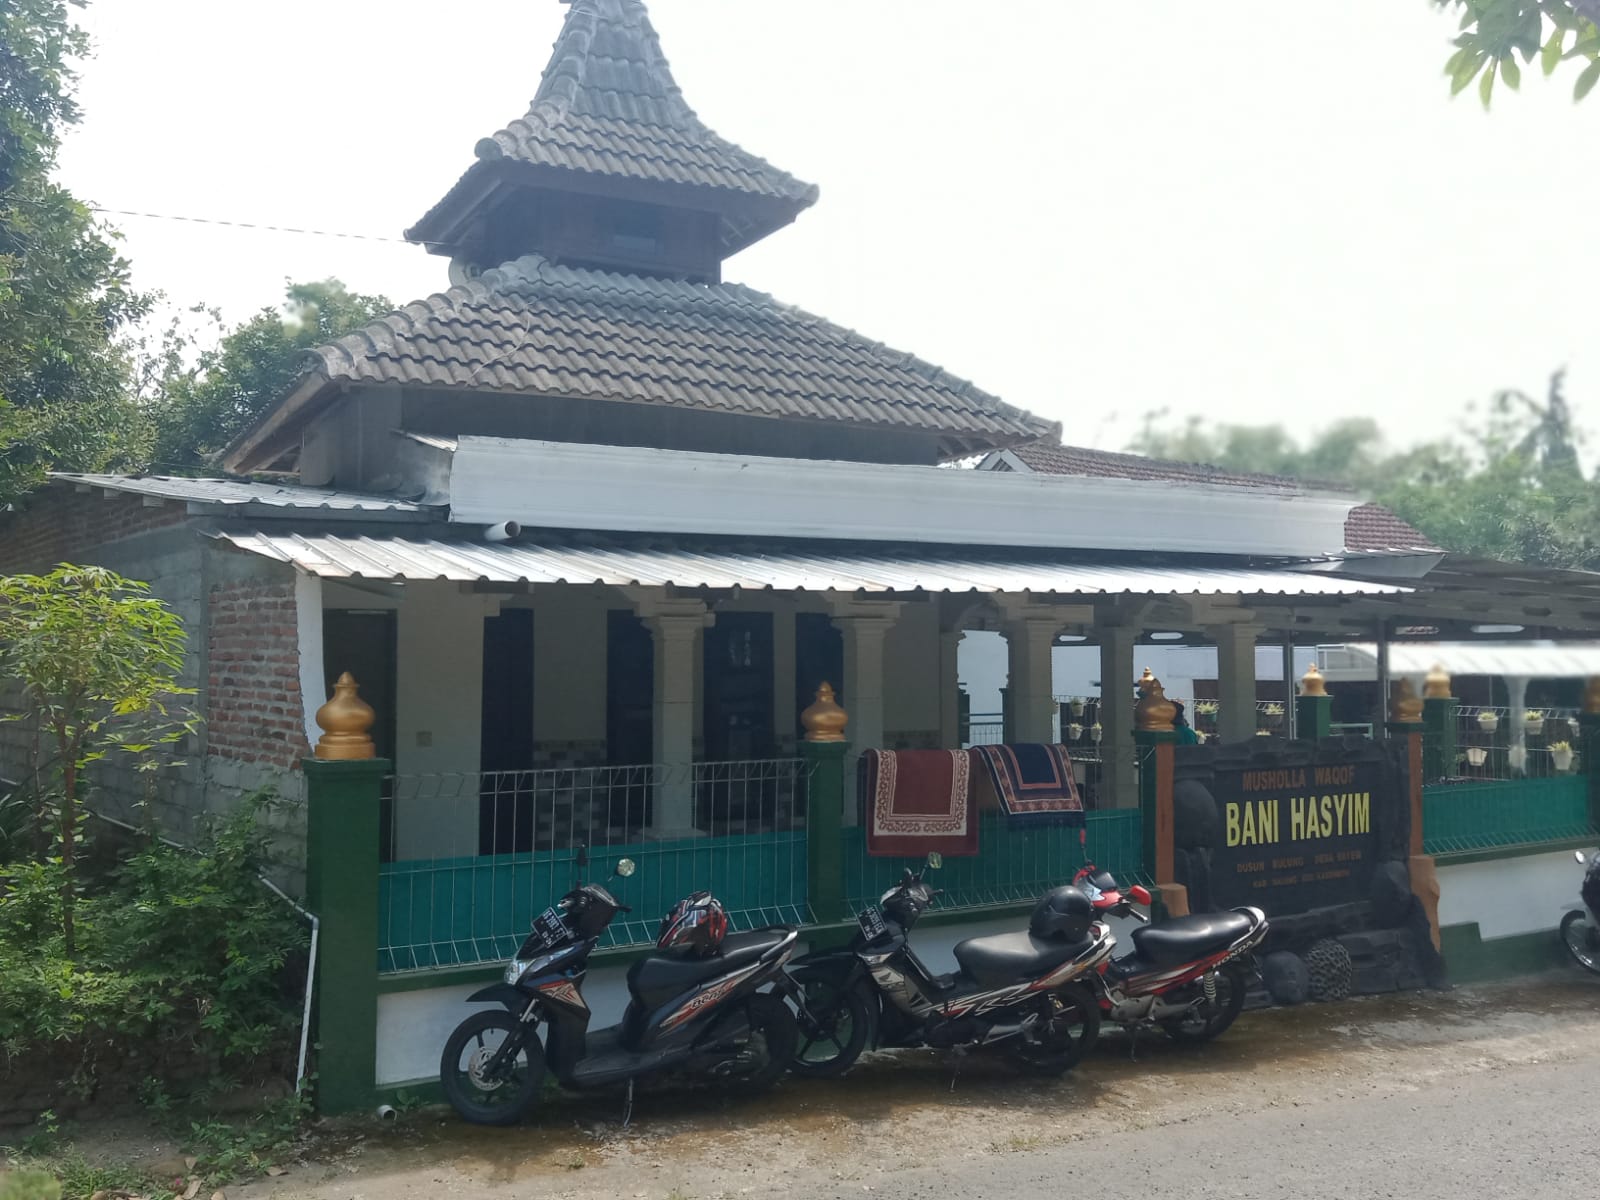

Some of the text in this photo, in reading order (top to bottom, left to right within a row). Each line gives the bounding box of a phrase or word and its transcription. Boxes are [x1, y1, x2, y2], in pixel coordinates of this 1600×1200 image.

[1242, 765, 1355, 792] MUSHOLLA WAQOF
[1226, 792, 1370, 847] BANI HASYIM
[1237, 861, 1265, 873] DUSUN
[1212, 940, 1254, 969] HONDA
